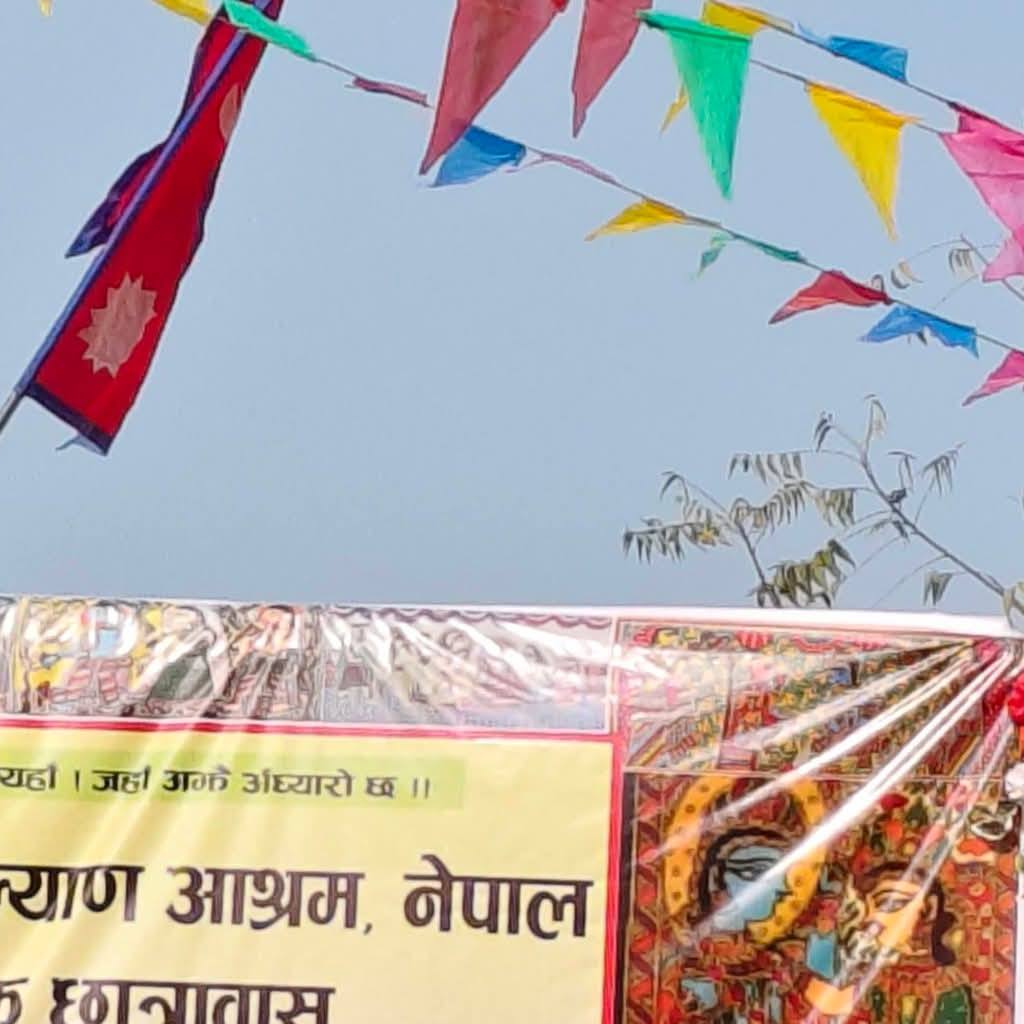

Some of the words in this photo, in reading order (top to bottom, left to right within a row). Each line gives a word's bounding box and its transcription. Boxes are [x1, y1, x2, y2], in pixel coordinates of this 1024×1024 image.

[364, 776, 399, 800] छ
[165, 866, 372, 935] आश्रम,
[402, 854, 594, 940] नेपाल
